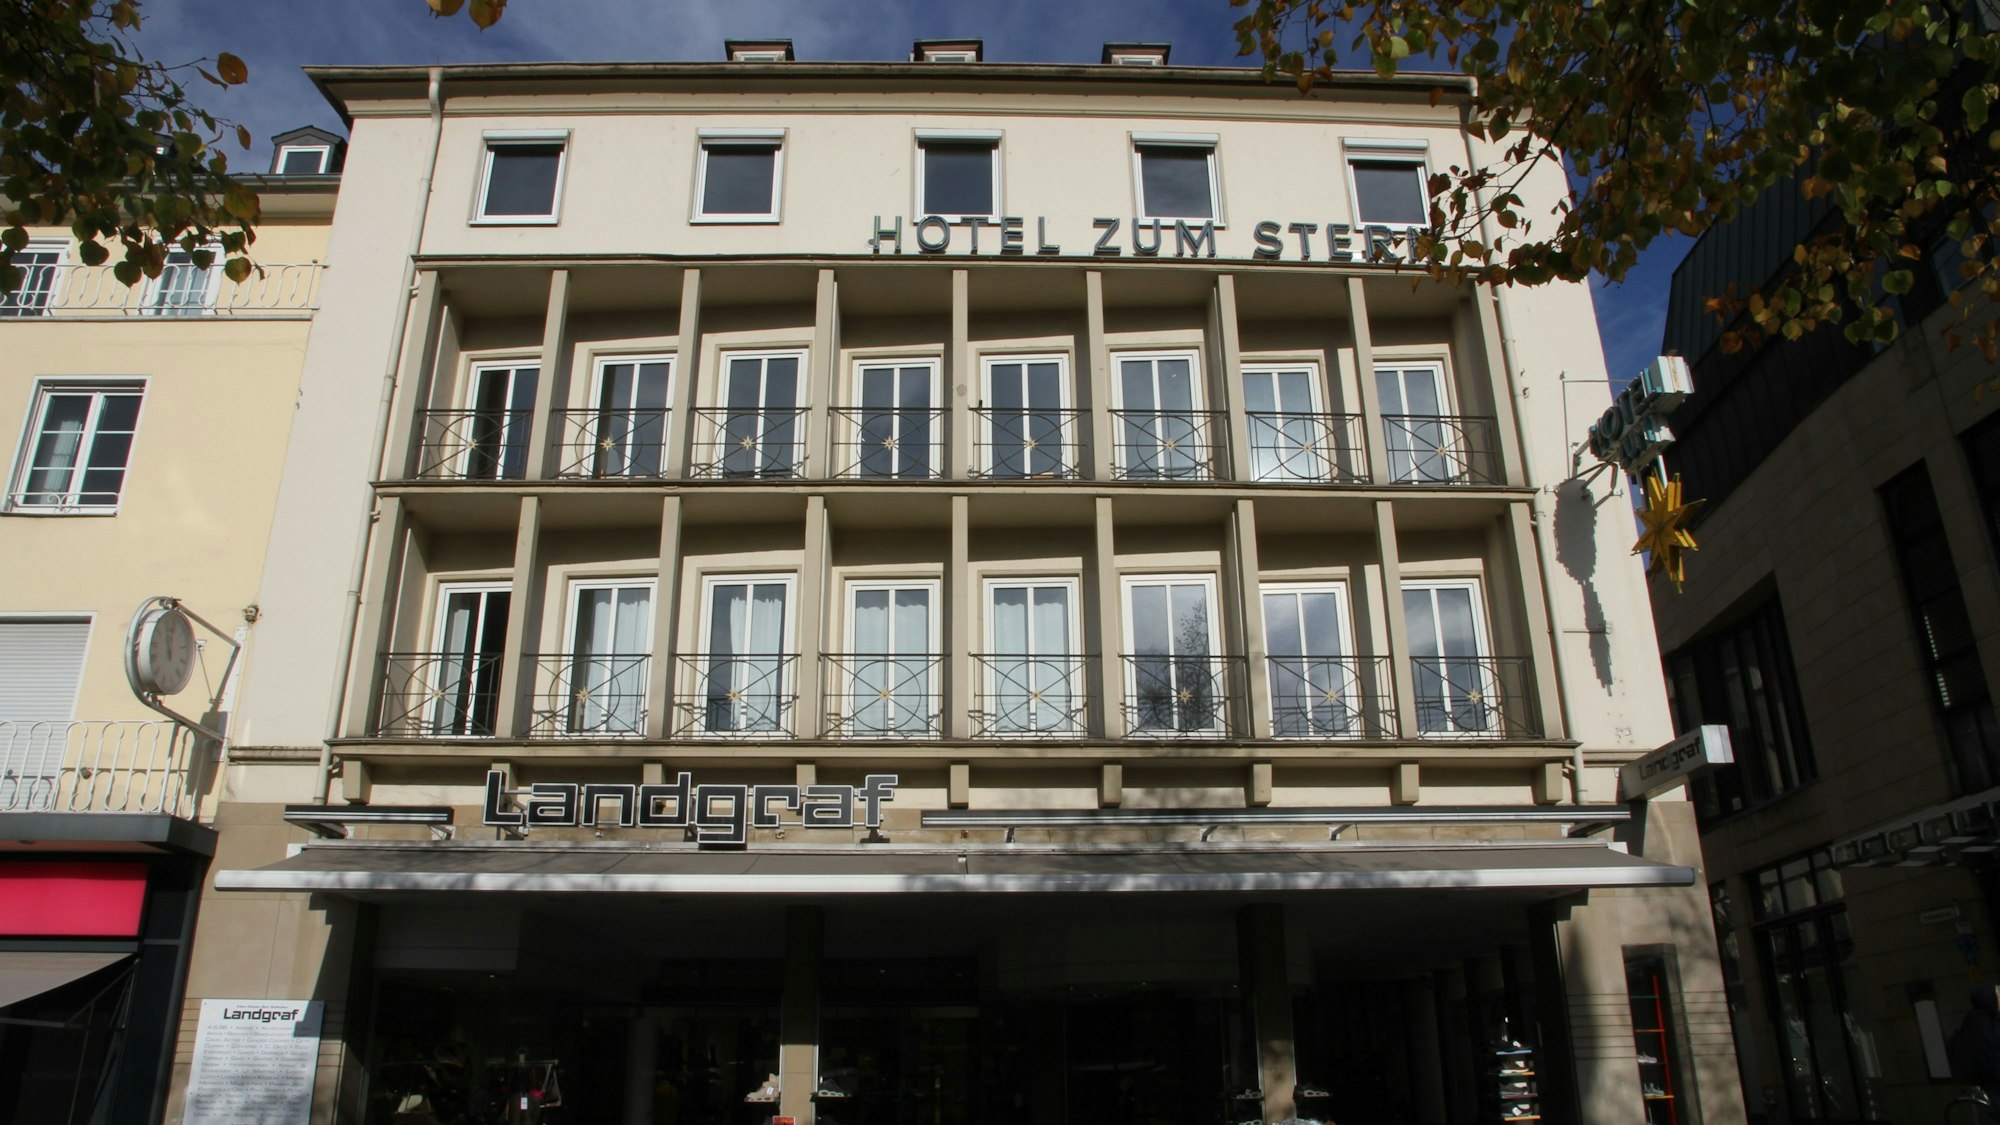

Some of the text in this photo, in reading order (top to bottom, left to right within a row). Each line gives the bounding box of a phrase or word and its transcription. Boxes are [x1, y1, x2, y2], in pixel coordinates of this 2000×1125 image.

[872, 215, 1060, 254] HOTEL
[1093, 217, 1217, 258] ZUM
[1638, 736, 1701, 781] Landgraf
[482, 770, 899, 849] Landgraf
[223, 1008, 299, 1023] Landgraf
